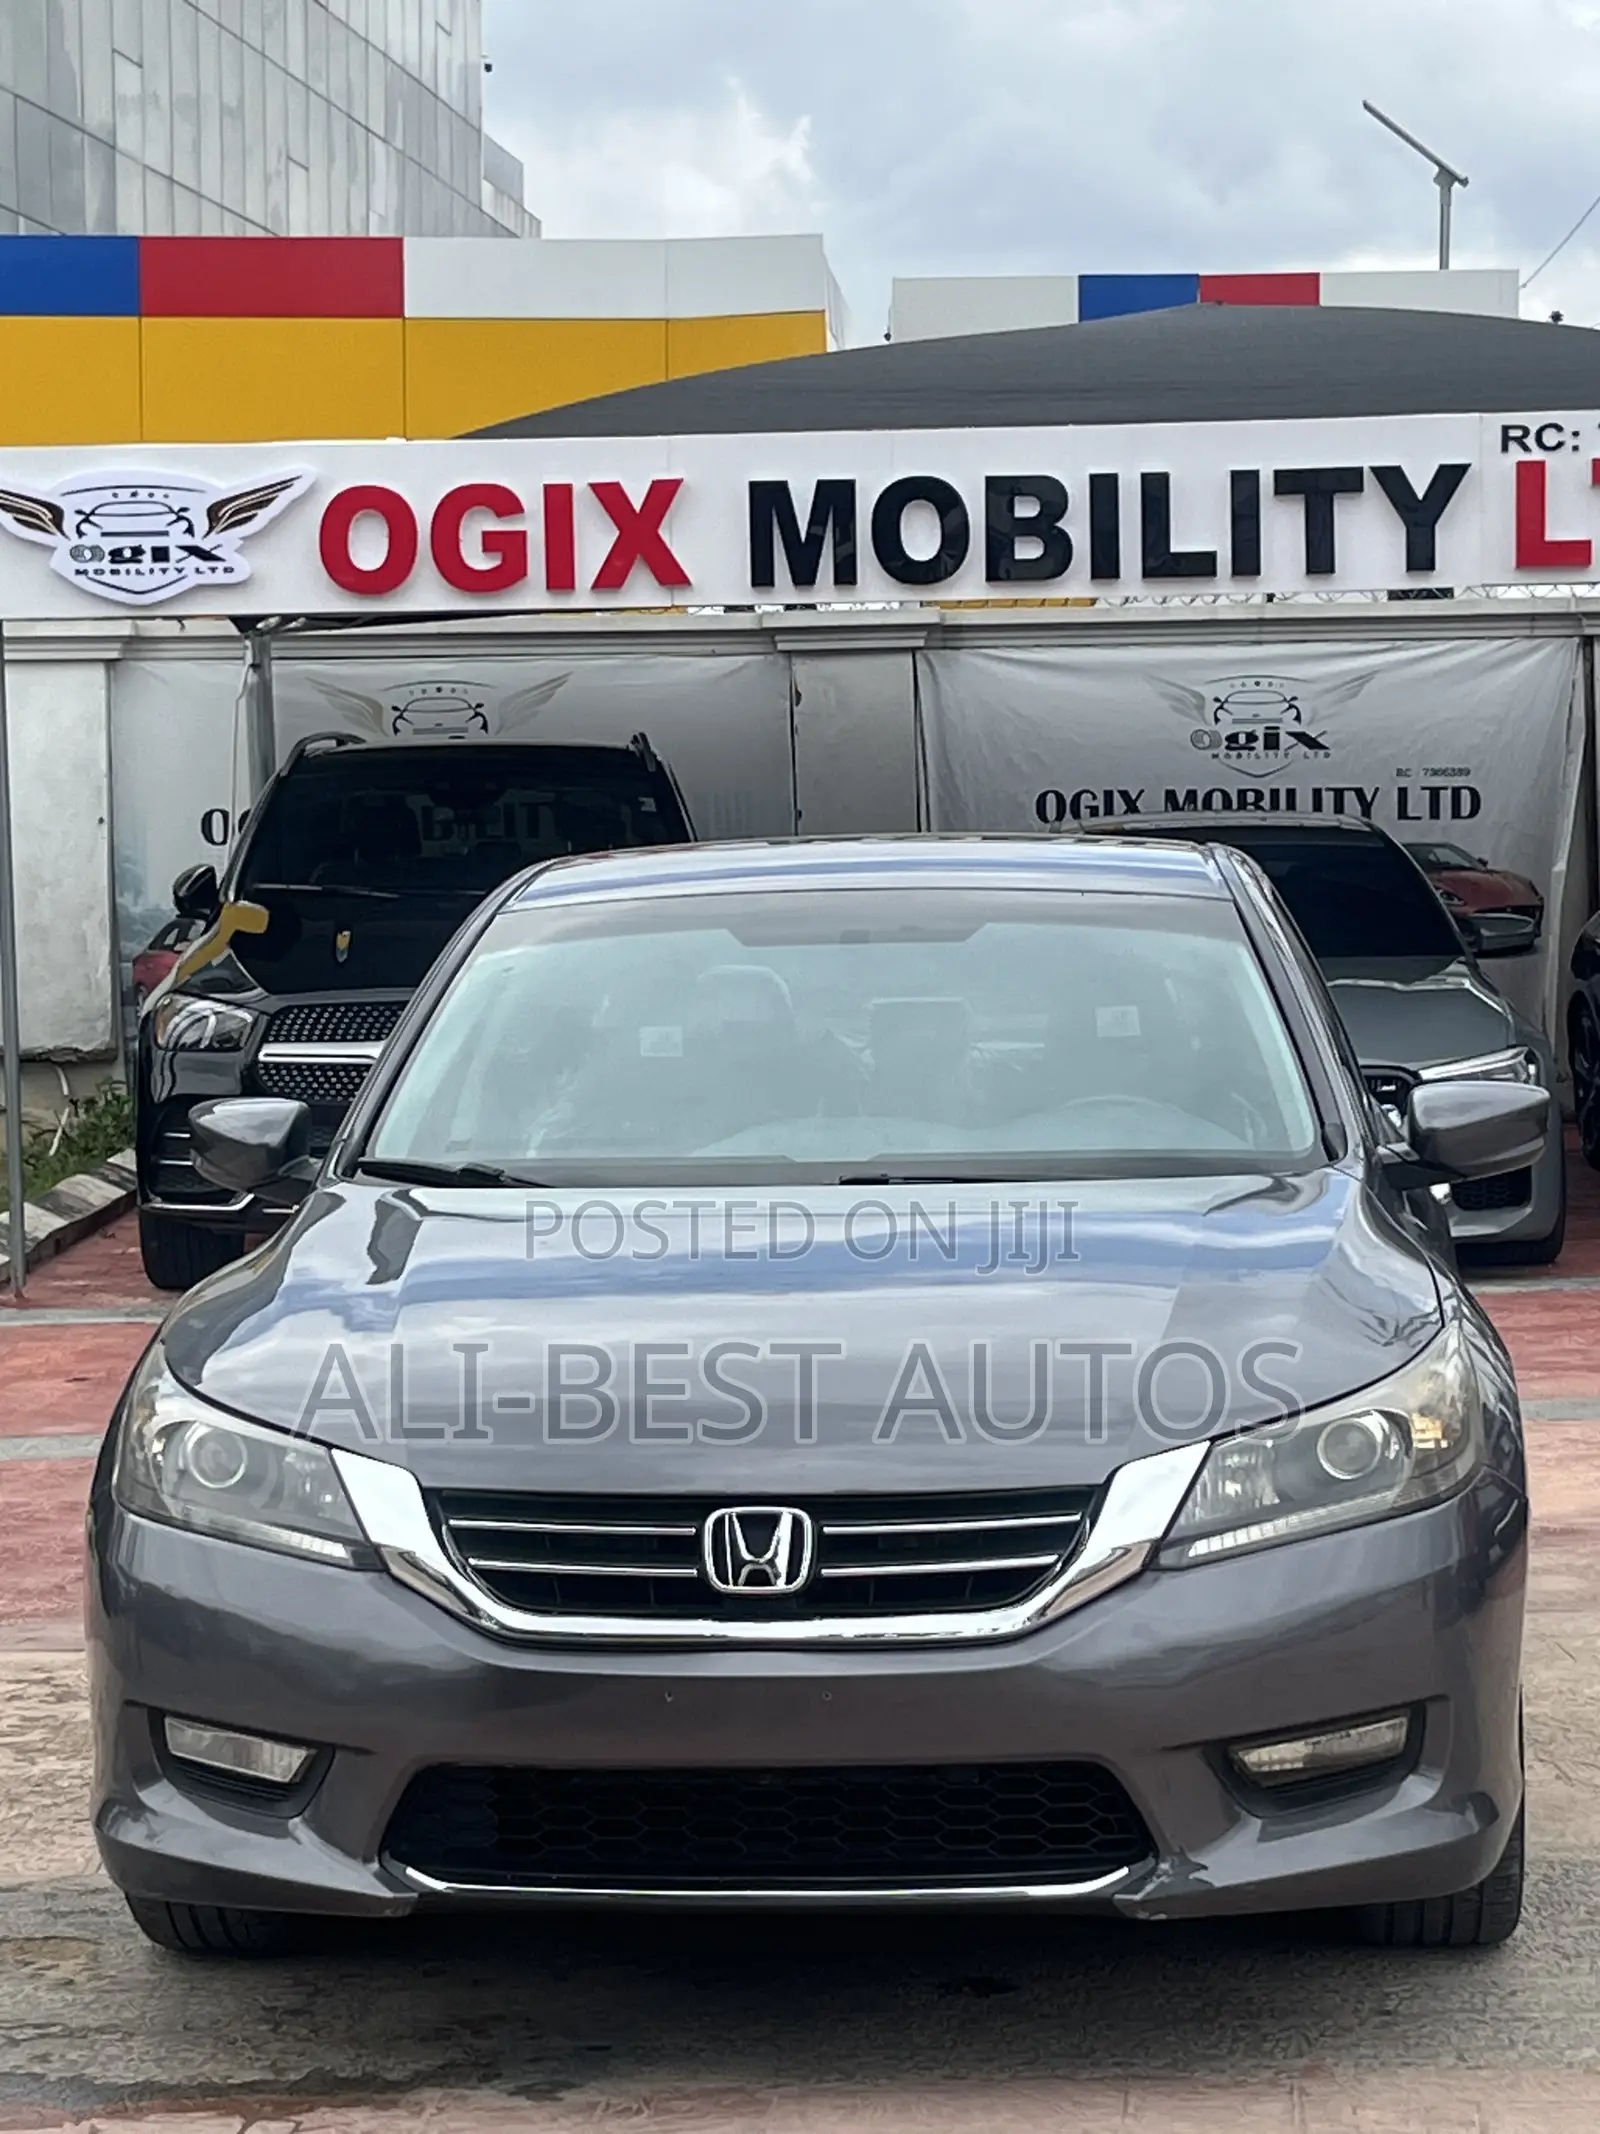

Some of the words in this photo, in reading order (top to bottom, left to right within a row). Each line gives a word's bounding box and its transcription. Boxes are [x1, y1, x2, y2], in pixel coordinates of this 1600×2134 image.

[1501, 423, 1580, 453] RC:
[319, 478, 692, 595] OGIX
[748, 463, 1471, 587] MOBILITY
[1036, 789, 1145, 824] OGIX
[1397, 786, 1482, 820] LTD
